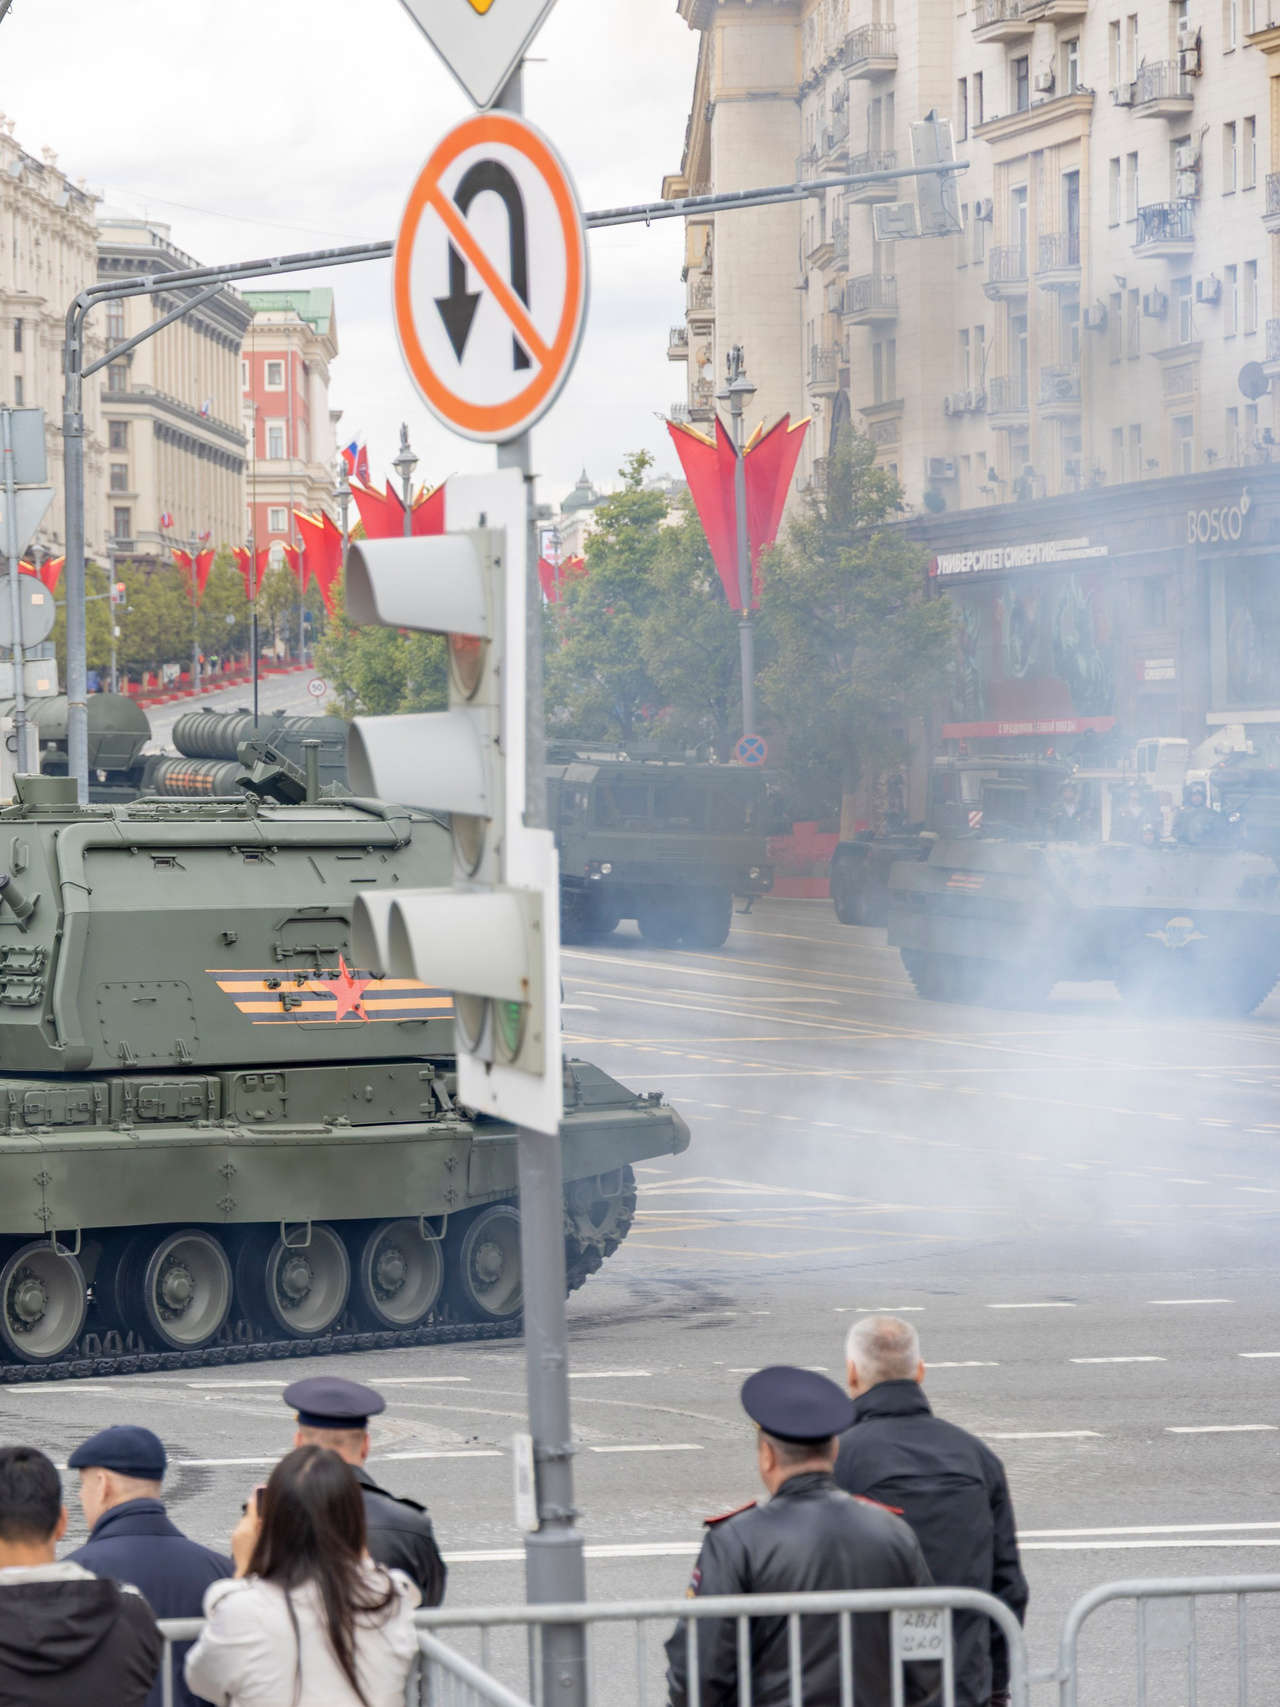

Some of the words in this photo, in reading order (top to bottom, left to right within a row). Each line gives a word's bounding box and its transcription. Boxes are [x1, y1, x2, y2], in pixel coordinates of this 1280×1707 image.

[1188, 503, 1242, 544] BOSCO
[937, 548, 1004, 576] УНИВЕРСИТЕТ
[1004, 540, 1056, 568] СИНЕРГИЯ
[312, 683, 323, 692] 50
